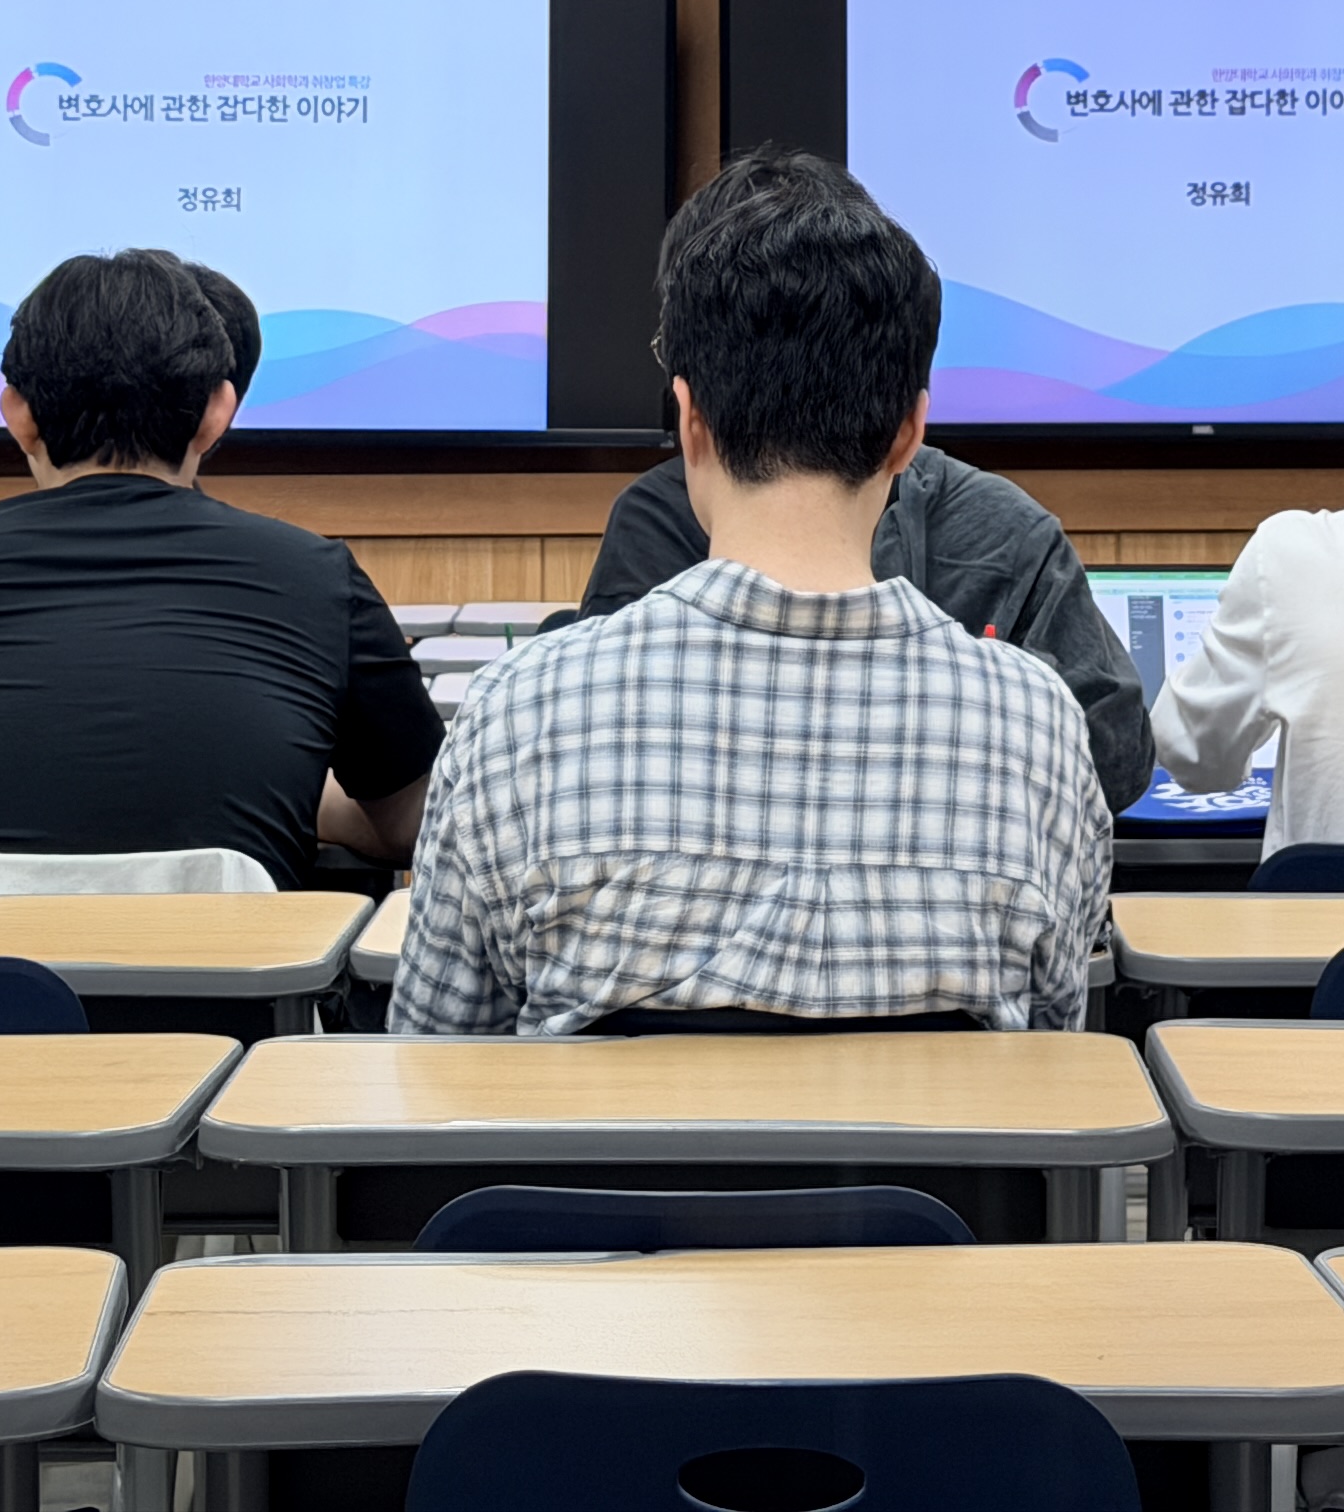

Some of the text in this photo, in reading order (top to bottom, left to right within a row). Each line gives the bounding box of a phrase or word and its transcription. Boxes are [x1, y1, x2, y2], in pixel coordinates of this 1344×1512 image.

[58, 94, 368, 124] 변호사에 관한 잡다한 이야기
[1066, 89, 1162, 117] 변호사에
[1168, 88, 1219, 117] 관한
[1225, 88, 1299, 117] 잡다한
